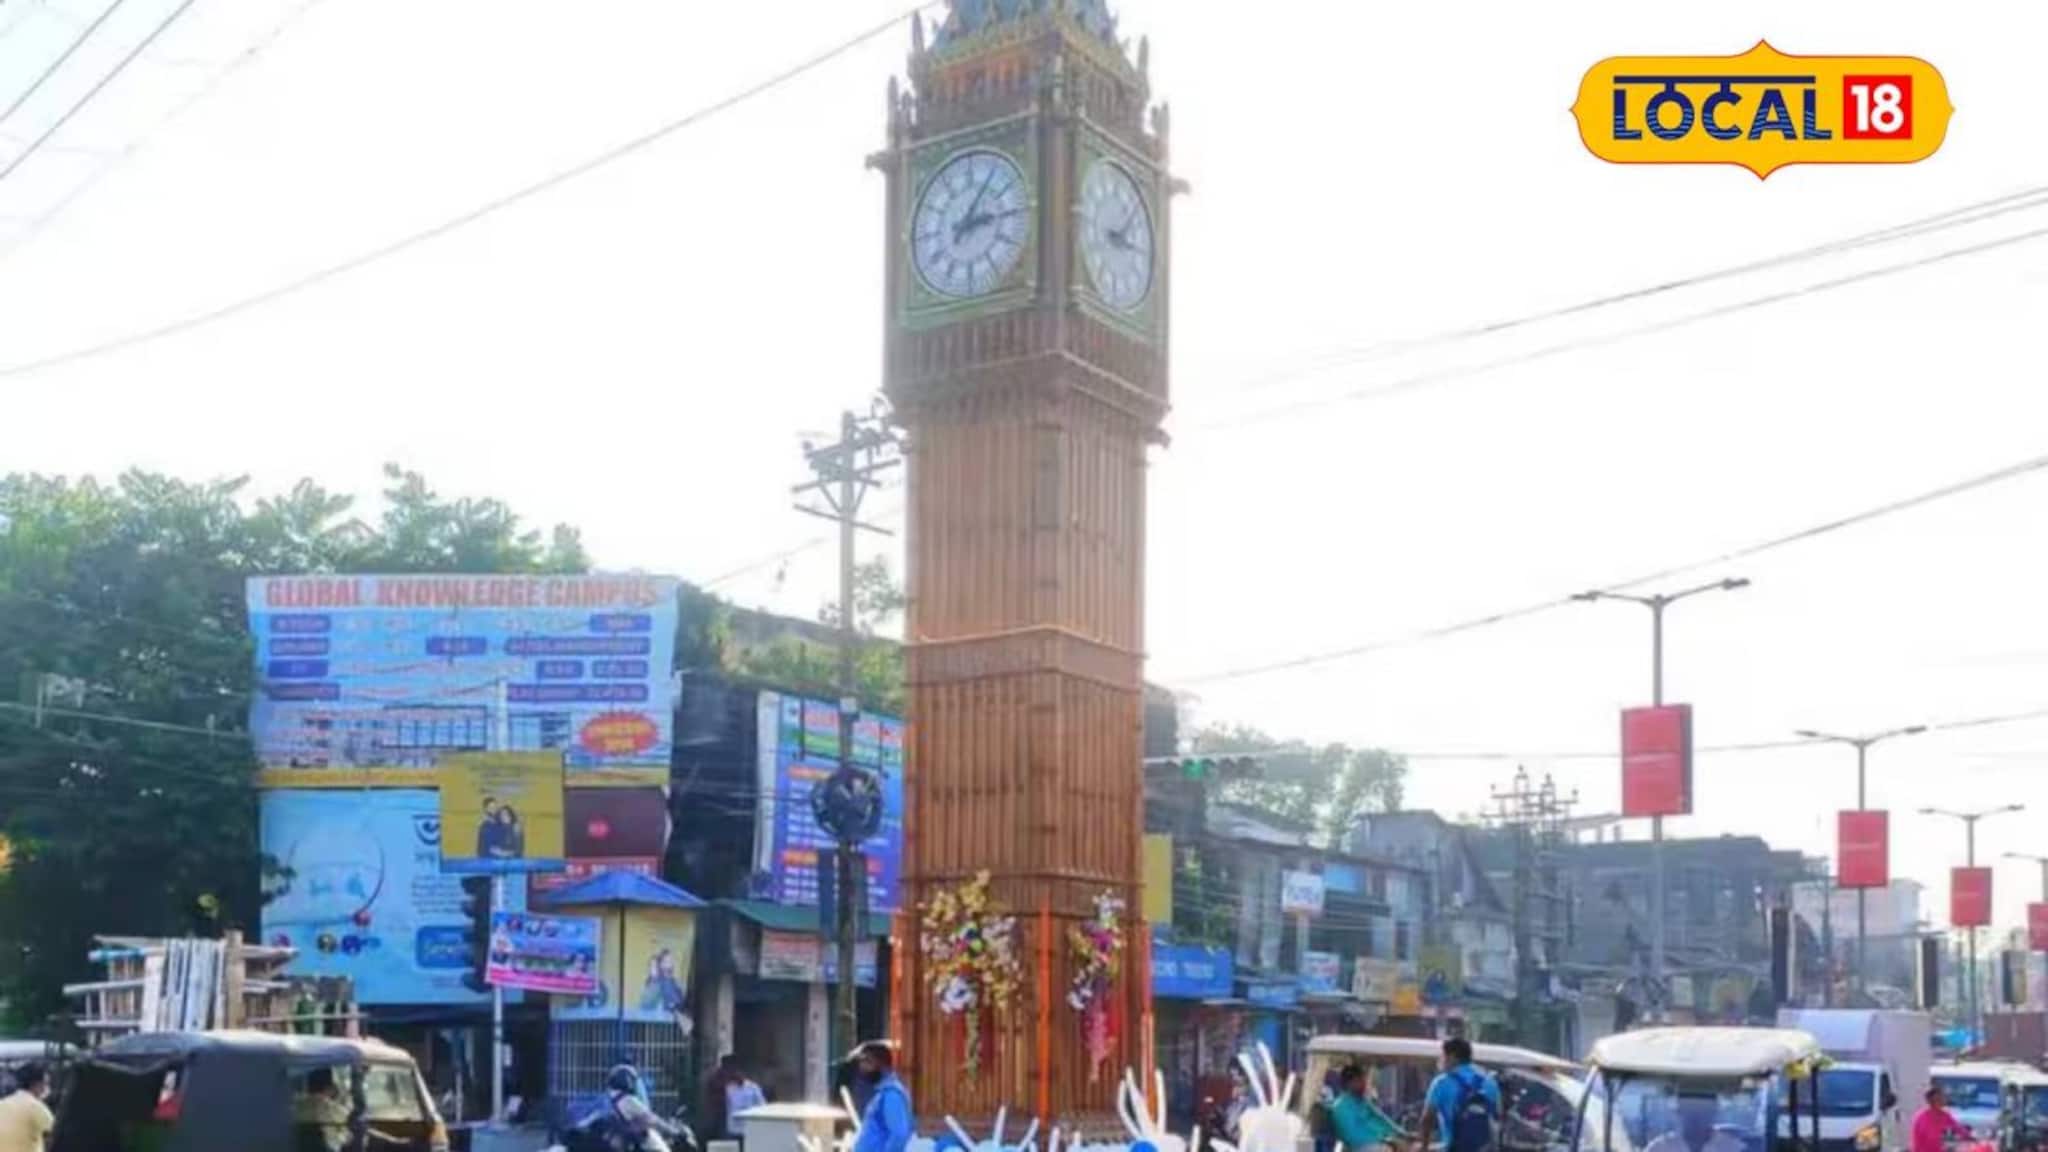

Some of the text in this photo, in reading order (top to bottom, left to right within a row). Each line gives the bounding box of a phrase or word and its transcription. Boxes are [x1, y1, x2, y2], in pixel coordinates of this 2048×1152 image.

[266, 577, 657, 608] GLOBAL KNOWLEDGE CAMPUS
